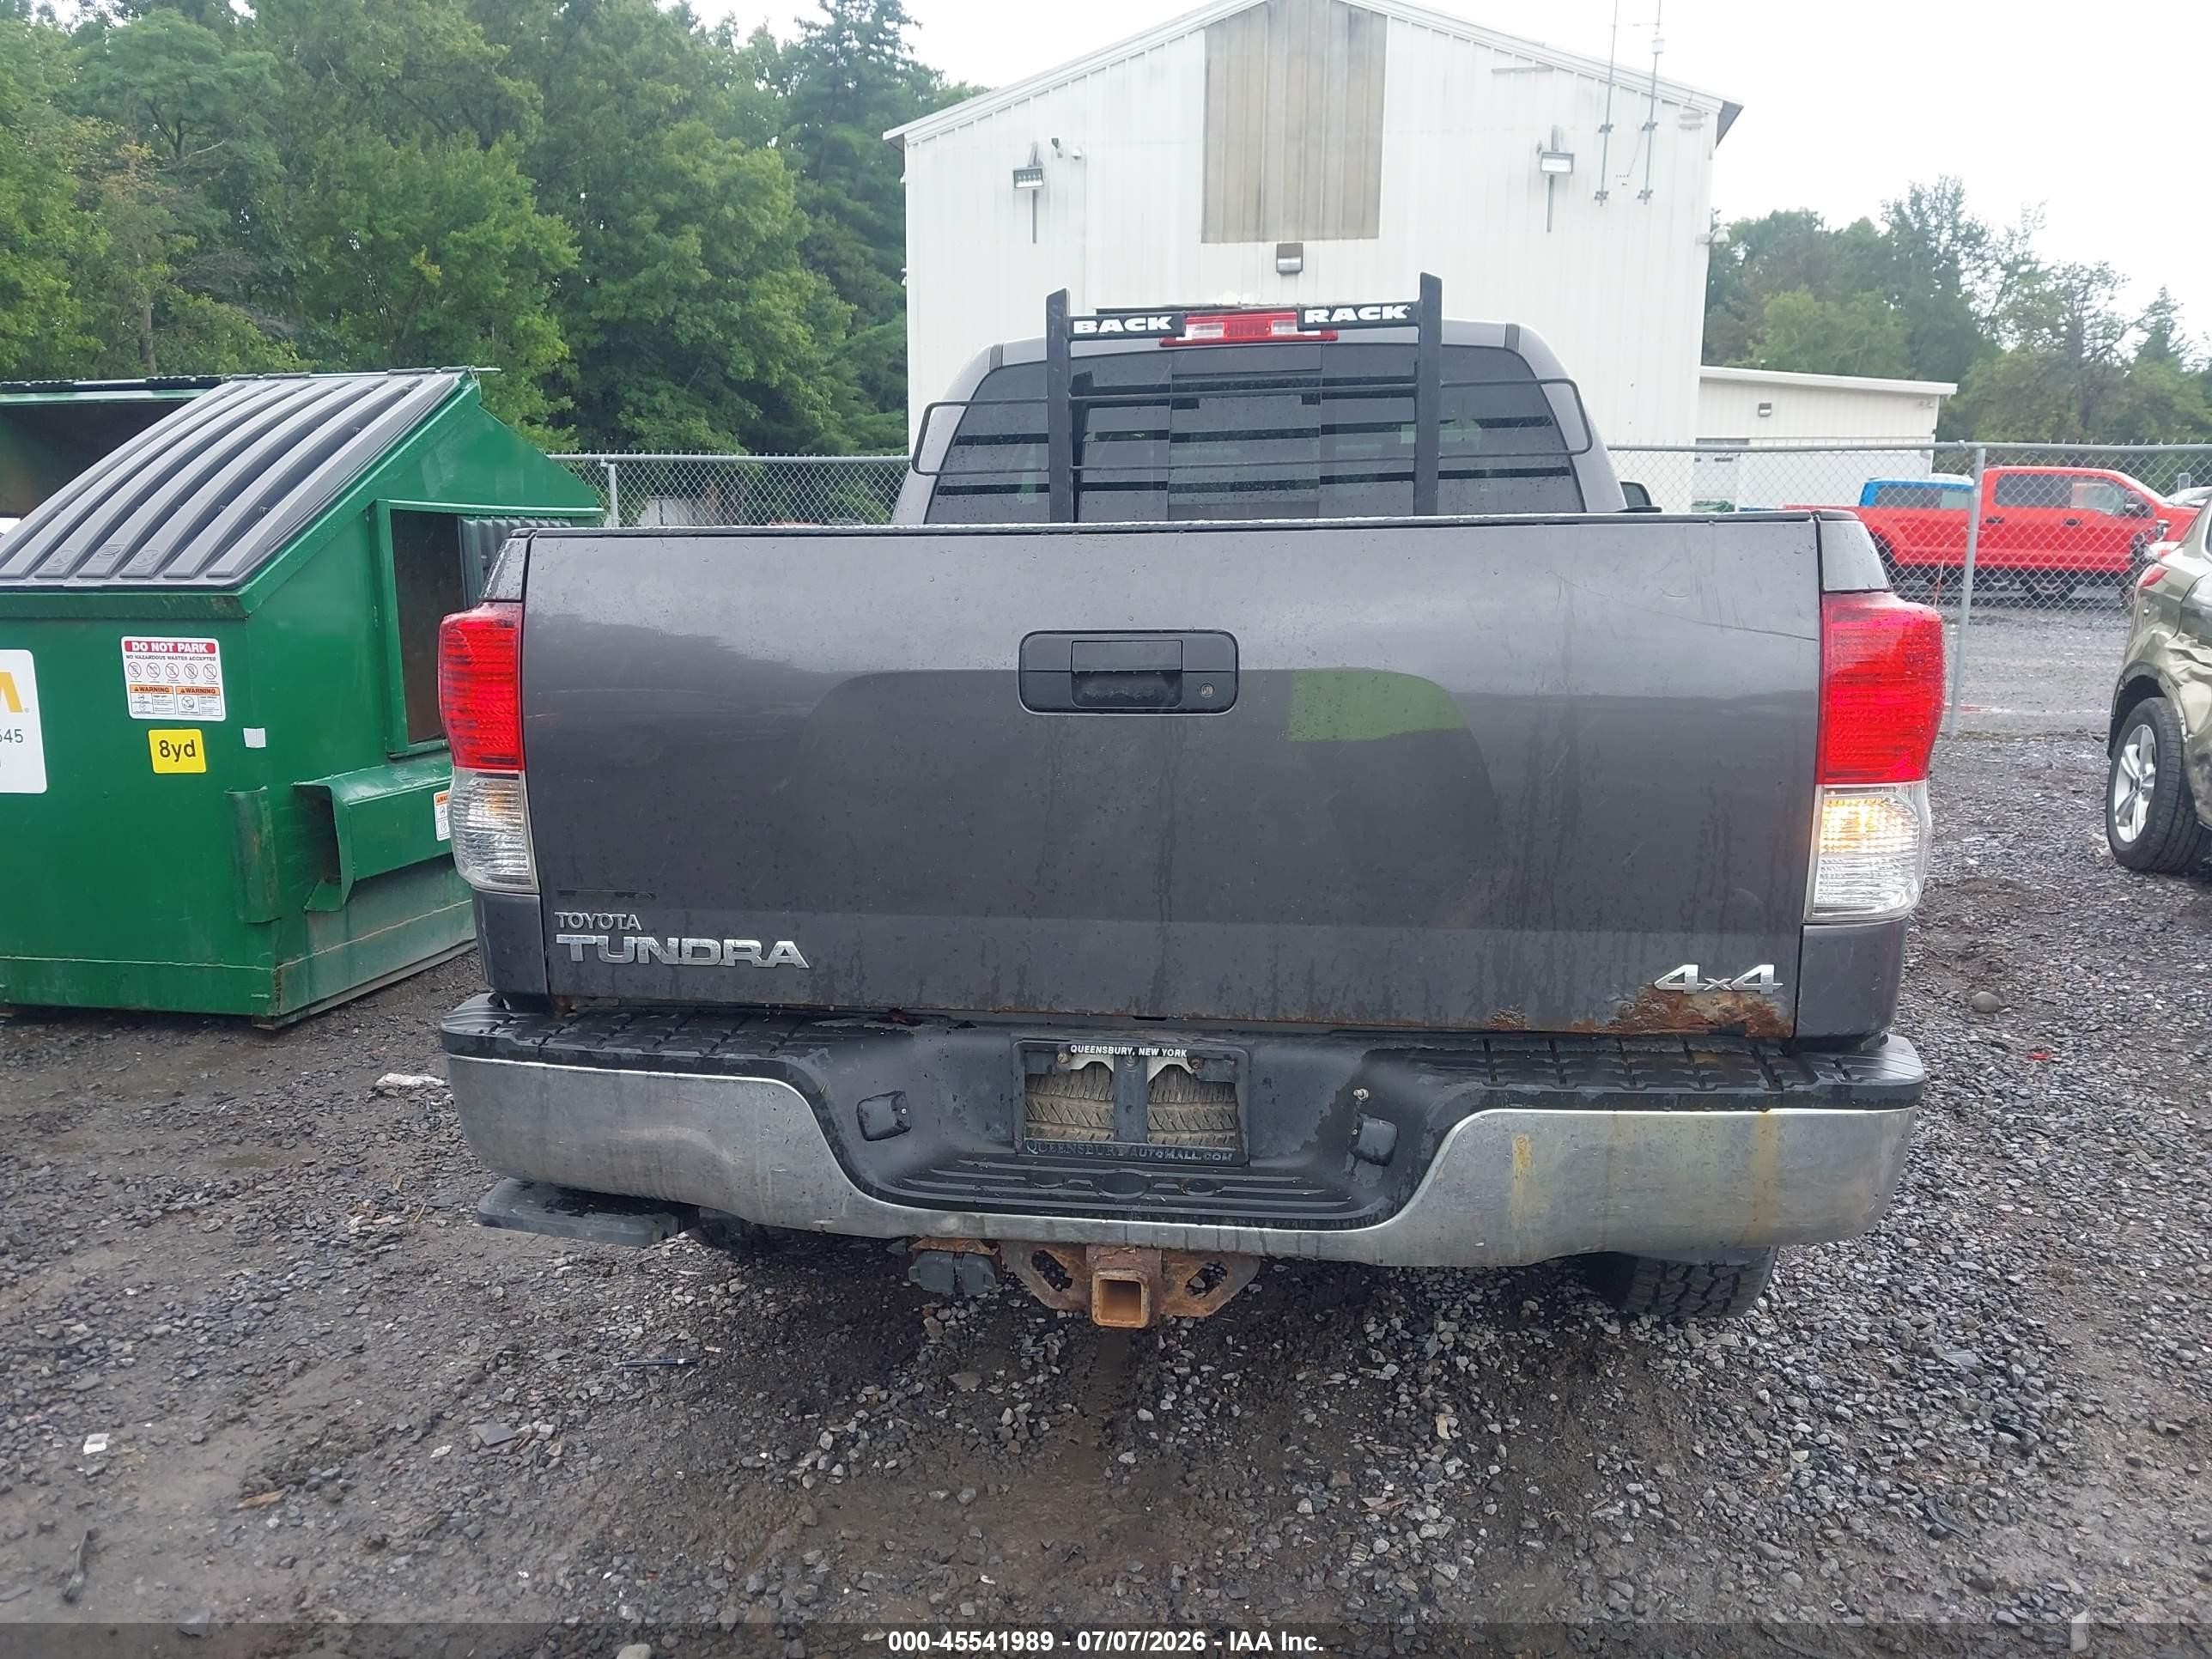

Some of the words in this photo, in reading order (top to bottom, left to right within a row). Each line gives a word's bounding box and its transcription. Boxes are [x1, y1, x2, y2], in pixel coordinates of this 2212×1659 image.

[1073, 316, 1174, 334] BACK
[1304, 304, 1410, 324] RACK
[131, 641, 149, 652] DO
[150, 642, 175, 653] NOT
[177, 643, 208, 653] PARK
[0, 728, 24, 744] 45
[159, 738, 196, 762] 8yd
[554, 911, 642, 932] TOYOTA
[556, 933, 811, 969] TUNDRA
[1654, 963, 1784, 994] 4x4
[1070, 1044, 1135, 1056] QUEENSBURY,
[1139, 1047, 1162, 1057] NEW
[1162, 1048, 1188, 1058] YORK
